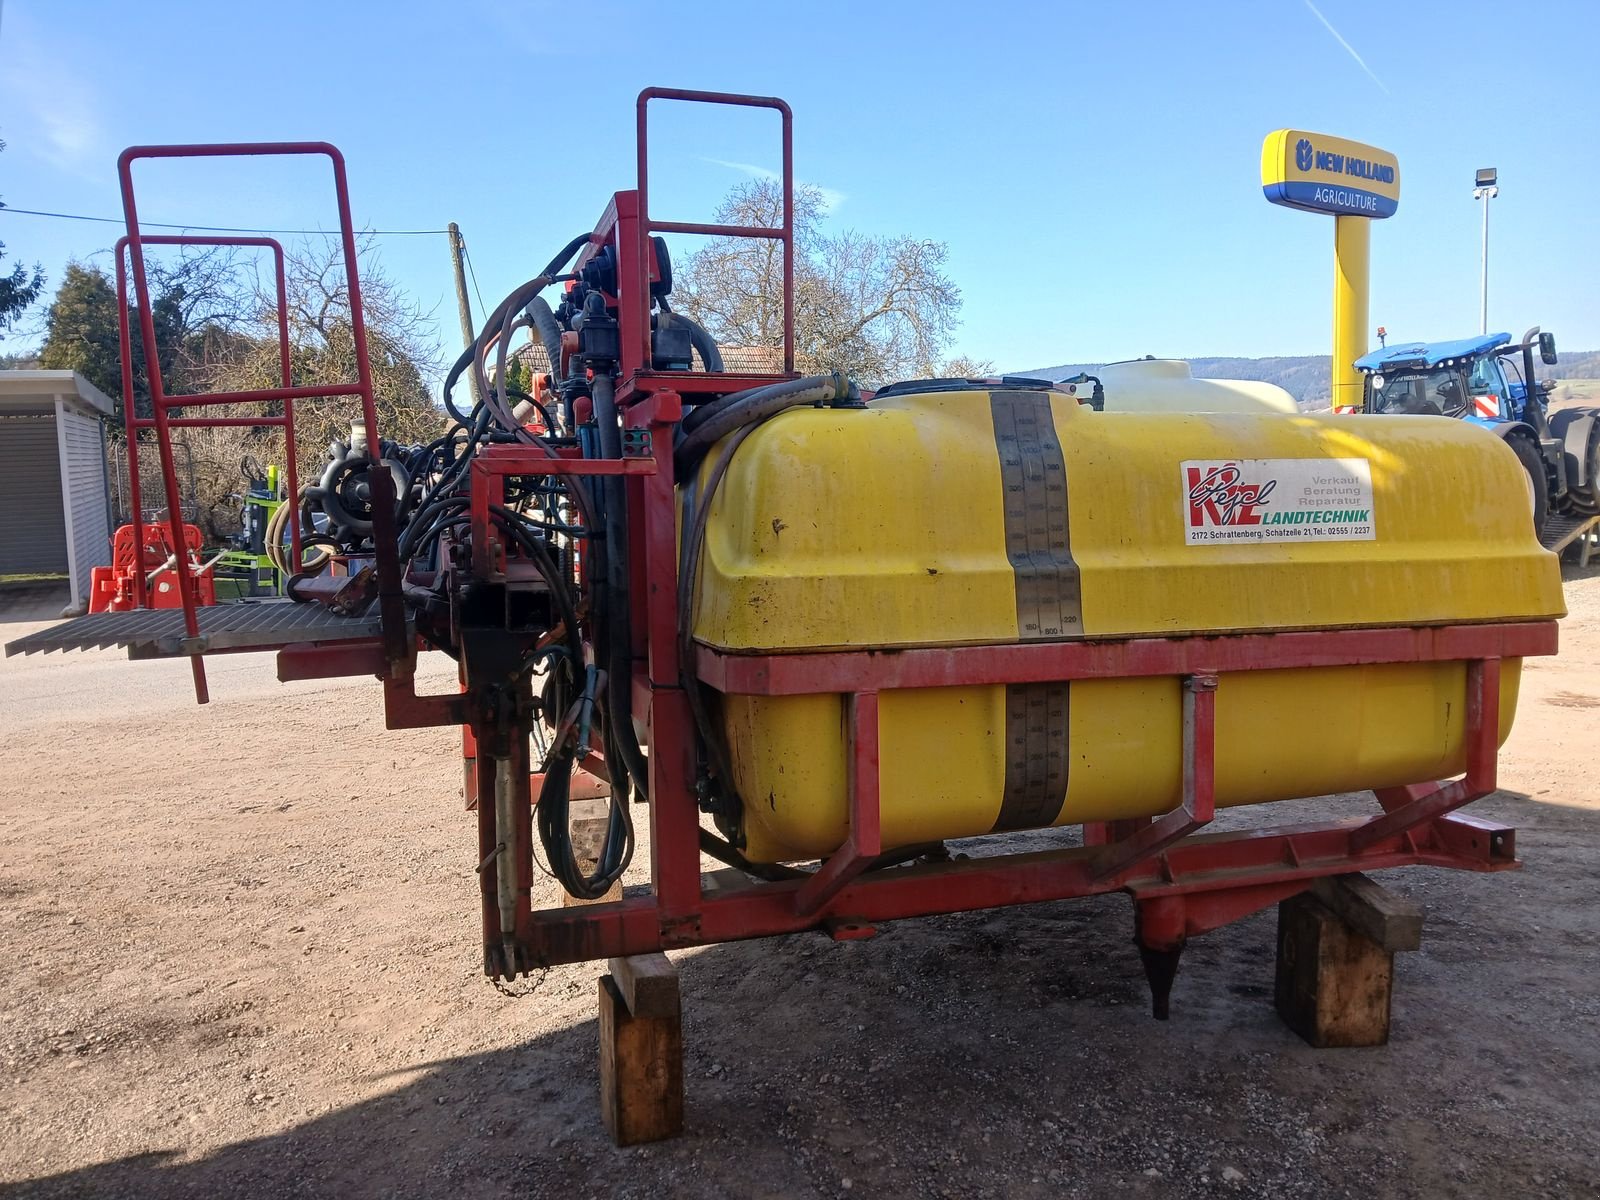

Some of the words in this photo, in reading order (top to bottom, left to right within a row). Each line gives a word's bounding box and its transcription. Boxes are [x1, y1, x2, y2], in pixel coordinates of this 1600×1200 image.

[1316, 151, 1344, 173] NEW
[1346, 157, 1394, 184] HOLLAND
[1314, 187, 1377, 211] AGRICULTURE
[1312, 476, 1360, 485] Verkauf
[1303, 487, 1361, 496] Beratung
[1299, 497, 1361, 507] Reparatur
[1262, 510, 1370, 525] LANDTECHNIK
[1210, 531, 1264, 539] Schrattenberg,
[1328, 526, 1349, 535] 02555
[1355, 526, 1370, 535] 2237
